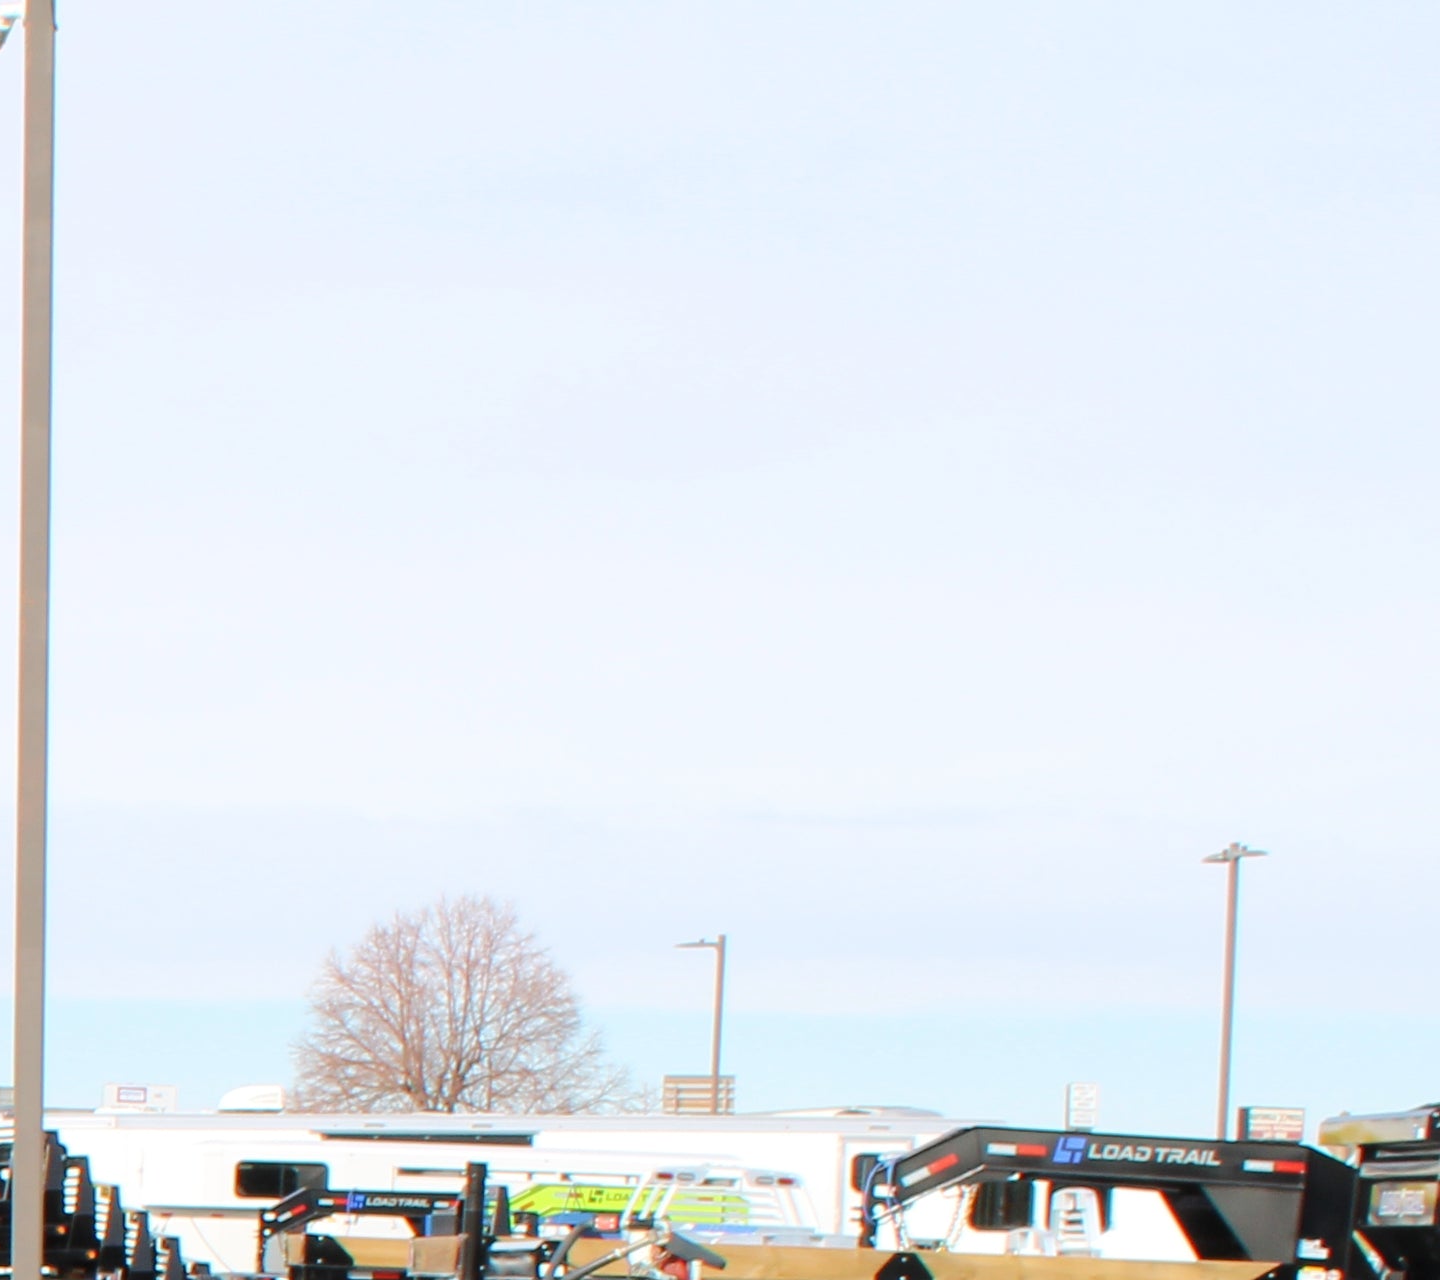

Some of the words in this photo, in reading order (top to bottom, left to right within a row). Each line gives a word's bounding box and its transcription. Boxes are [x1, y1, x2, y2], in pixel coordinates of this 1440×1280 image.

[1087, 1143, 1153, 1162] LOAD
[1154, 1147, 1222, 1167] TRAIL
[365, 1197, 397, 1207] LOAD
[398, 1198, 432, 1208] TRAIL
